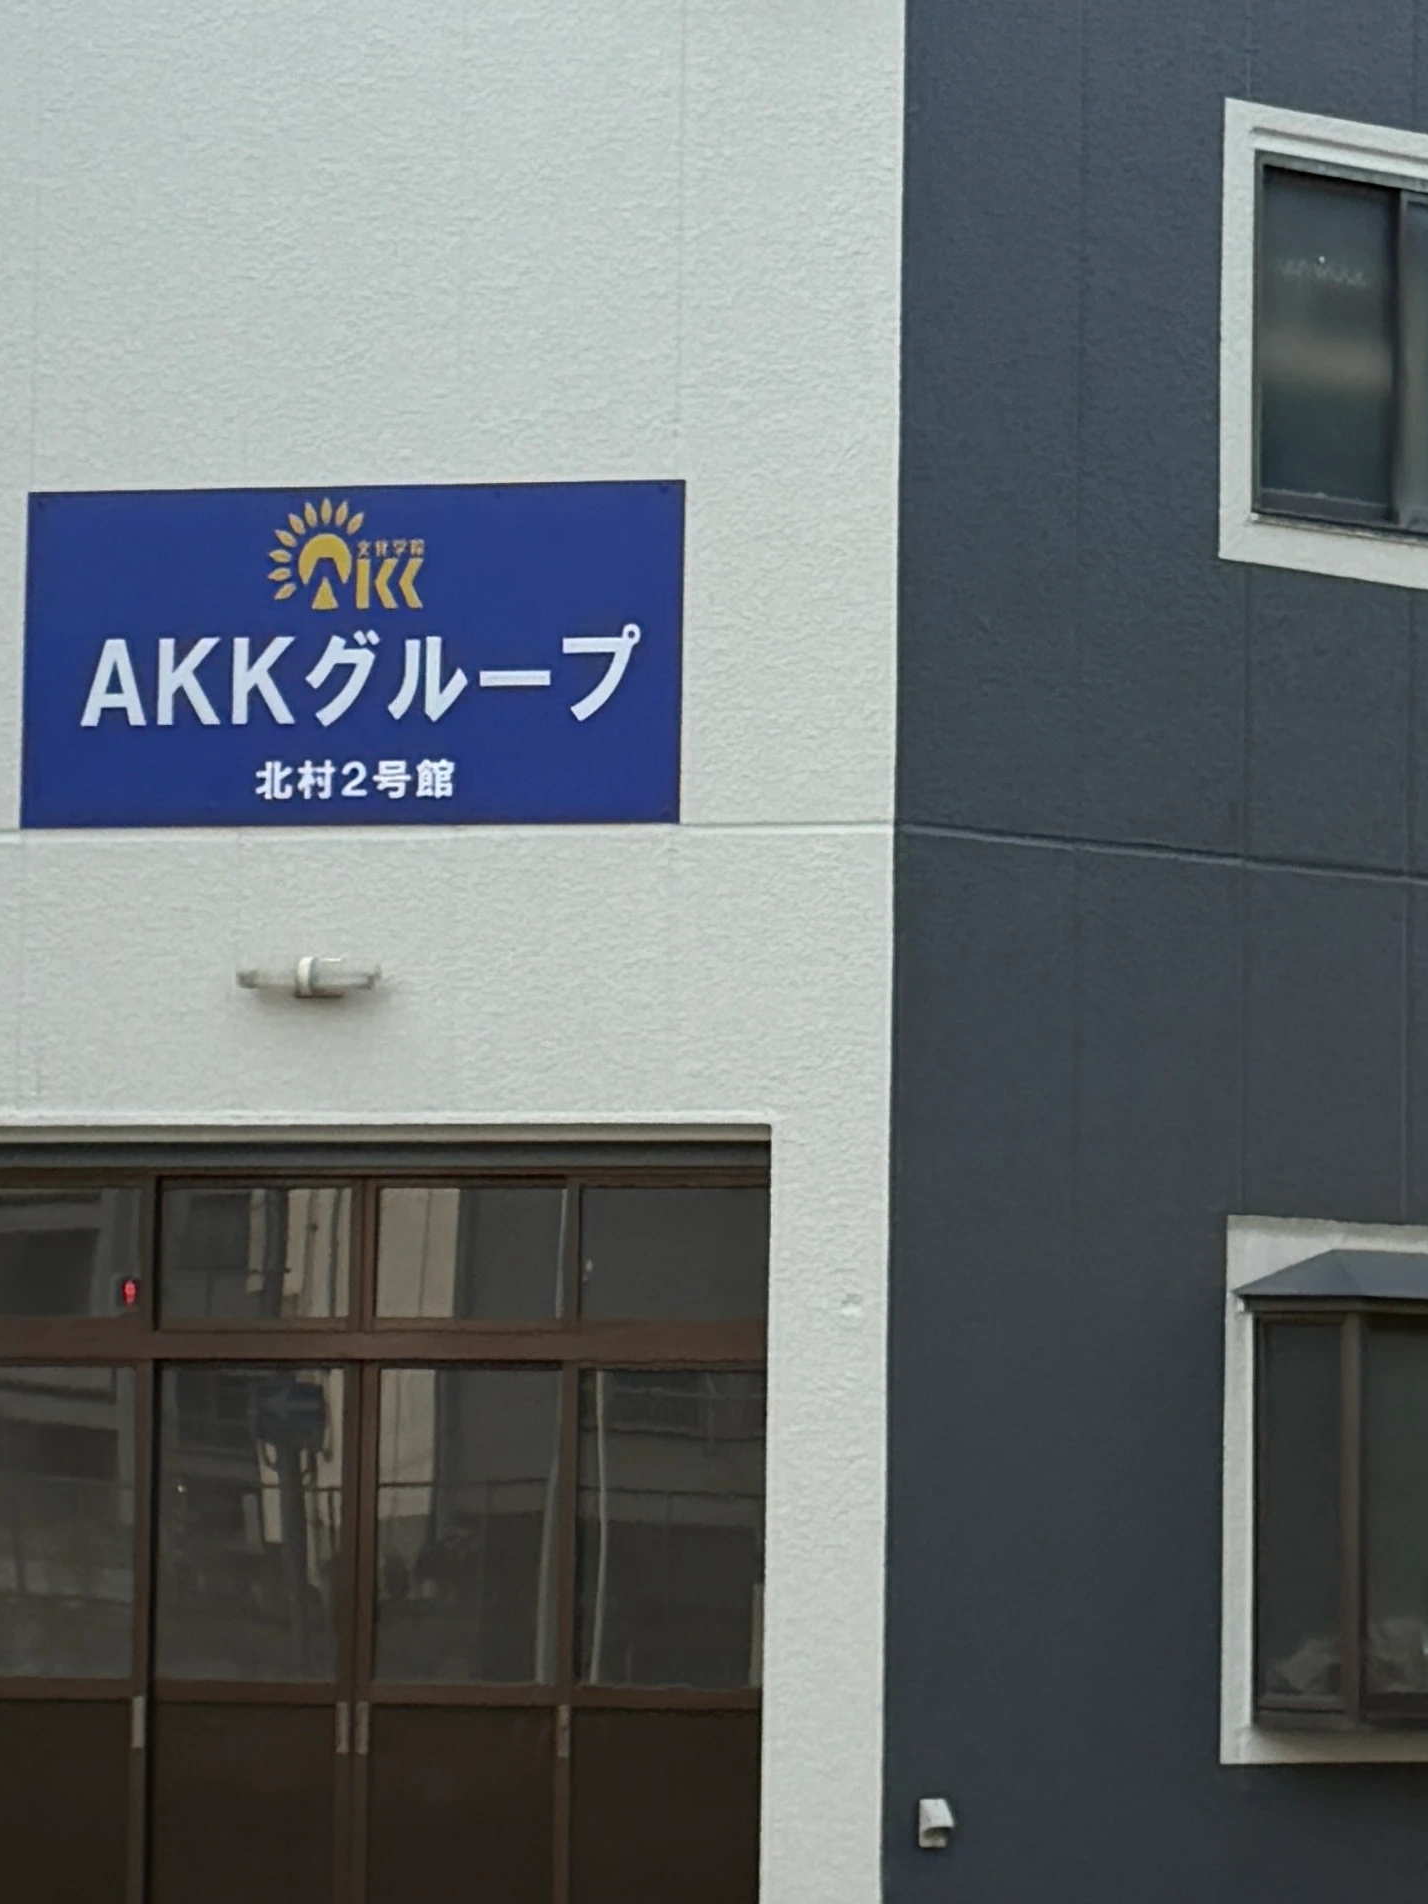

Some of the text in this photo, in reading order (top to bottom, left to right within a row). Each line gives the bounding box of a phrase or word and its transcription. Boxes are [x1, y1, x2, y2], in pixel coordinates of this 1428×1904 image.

[80, 623, 642, 728] AKKグループ
[255, 757, 456, 800] 北村2号館
